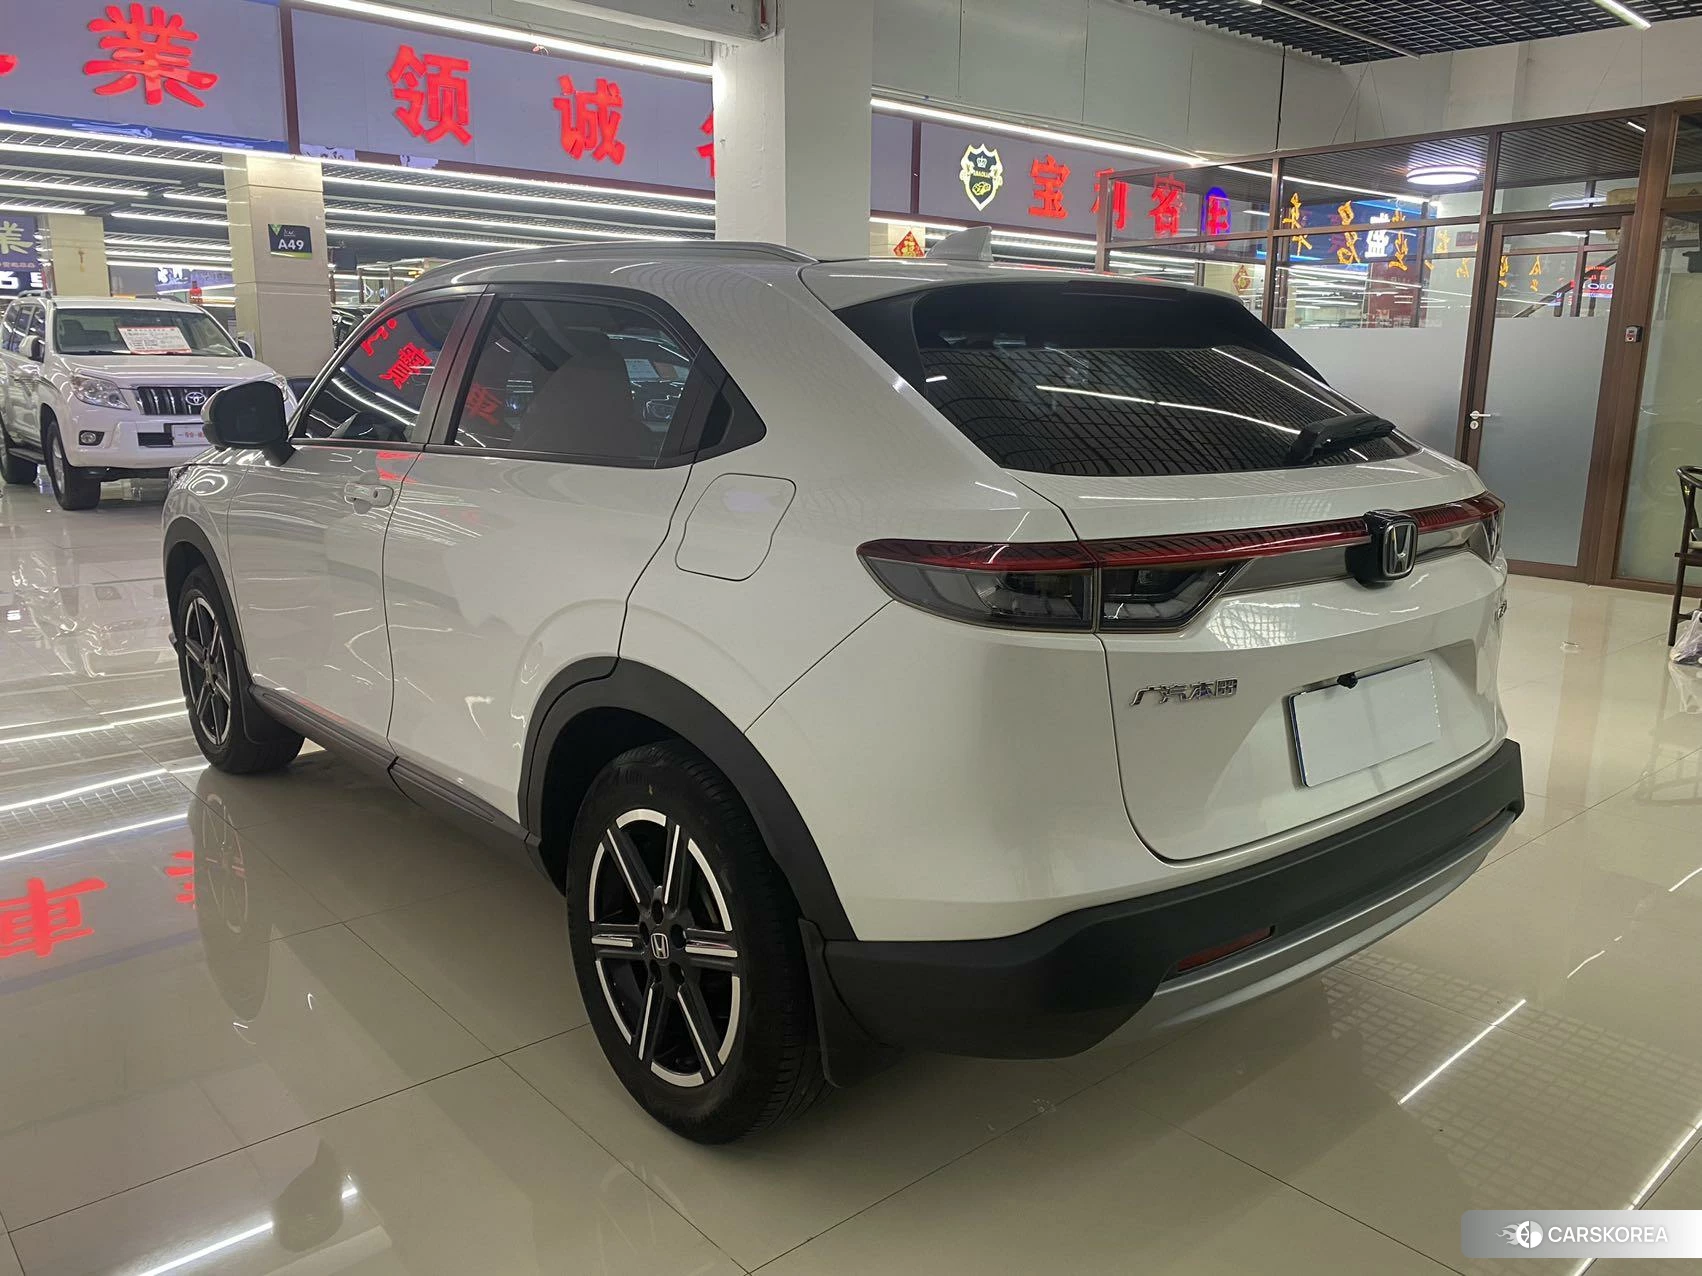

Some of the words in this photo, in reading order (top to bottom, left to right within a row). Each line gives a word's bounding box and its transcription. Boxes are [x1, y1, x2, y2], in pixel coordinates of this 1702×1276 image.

[83, 3, 220, 108] 業
[278, 239, 305, 250] A49
[1129, 677, 1239, 706] 广汽本田
